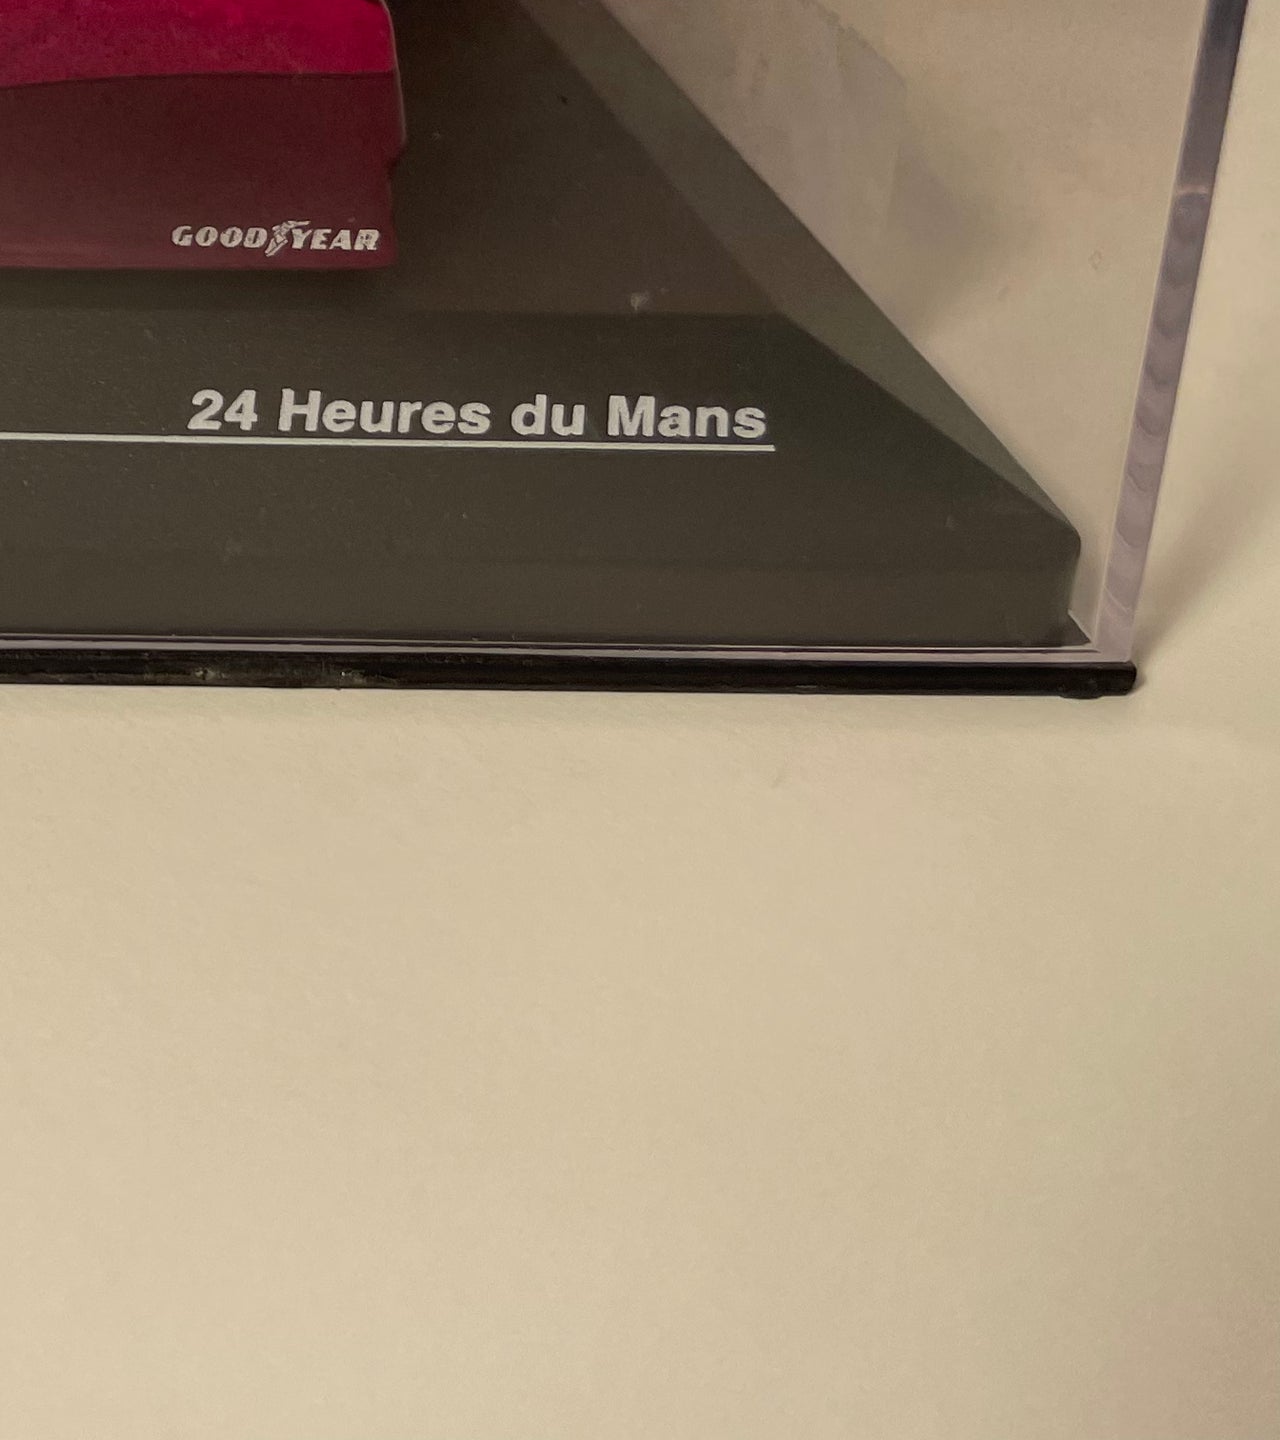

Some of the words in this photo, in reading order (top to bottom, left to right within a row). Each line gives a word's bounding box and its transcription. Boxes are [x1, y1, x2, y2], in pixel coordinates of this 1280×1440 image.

[170, 220, 382, 258] GOODYEAR
[186, 388, 258, 432] 24
[277, 387, 492, 436] Heures
[510, 394, 584, 437] du
[606, 395, 768, 439] Mans
